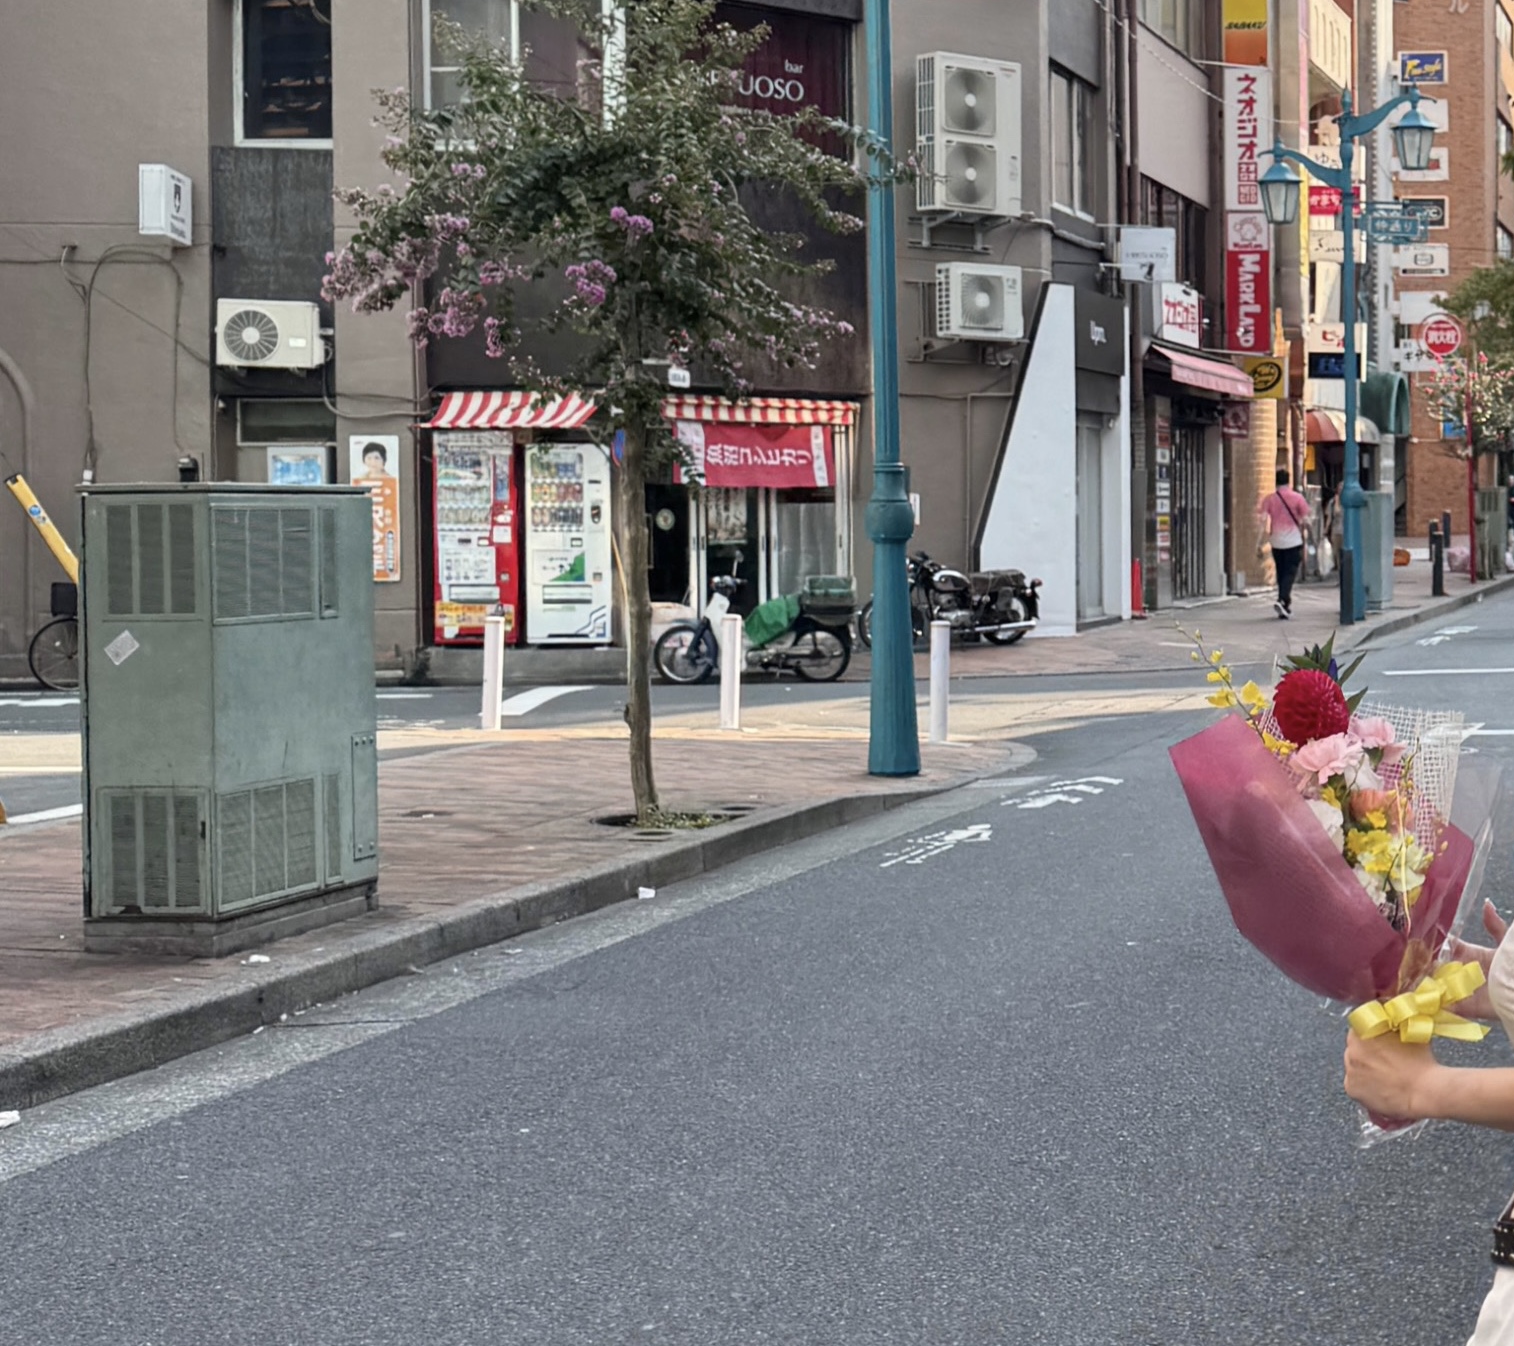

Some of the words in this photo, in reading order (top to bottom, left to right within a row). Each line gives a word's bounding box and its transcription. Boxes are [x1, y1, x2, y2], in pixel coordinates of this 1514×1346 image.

[784, 59, 804, 74] bar
[1237, 73, 1258, 161] ネオジオ
[1428, 330, 1457, 345] 消火栓
